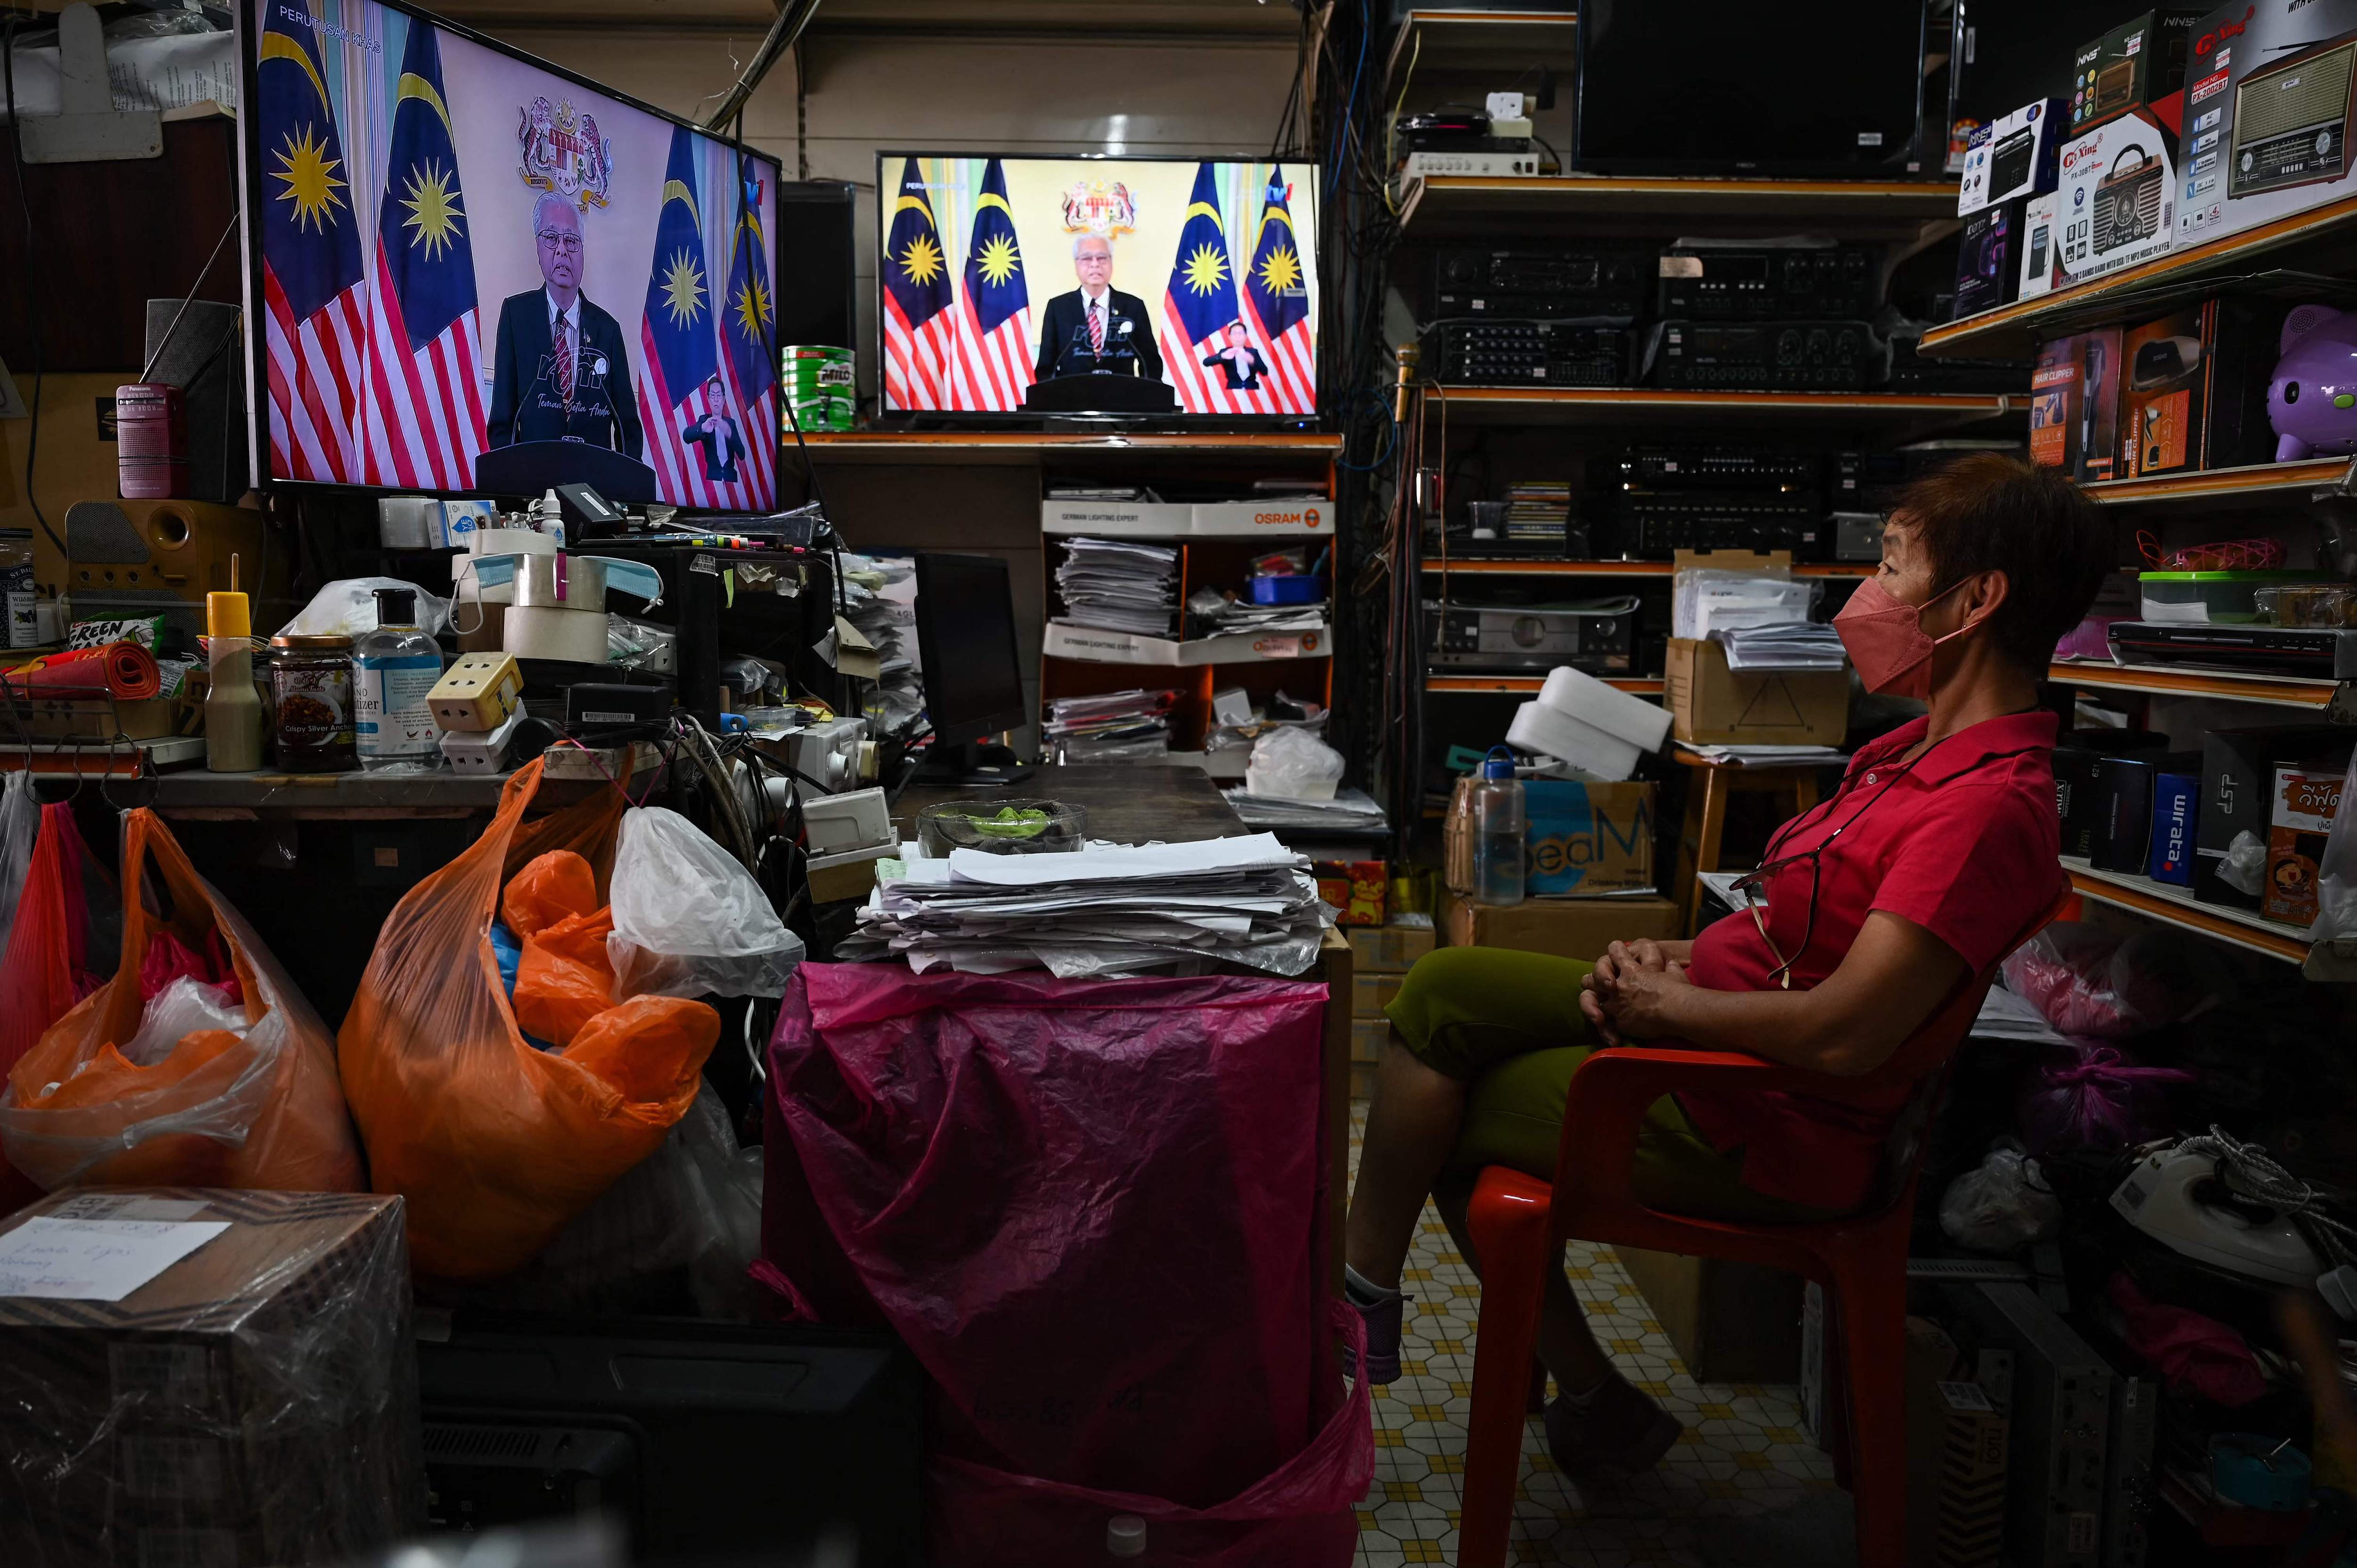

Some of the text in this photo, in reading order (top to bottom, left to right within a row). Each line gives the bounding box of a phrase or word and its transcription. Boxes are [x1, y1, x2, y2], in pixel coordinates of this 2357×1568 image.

[280, 6, 381, 53] PERUTUSAN KHAS
[2192, 80, 2227, 102] PX-2002BT
[2193, 80, 2209, 92] Model
[2078, 143, 2098, 161] Xing
[2083, 267, 2094, 278] BANDS
[2094, 263, 2106, 274] RADIO
[2106, 260, 2116, 271] WITH
[2140, 247, 2153, 258] MUSIC
[2153, 241, 2169, 255] PLAYER
[822, 369, 850, 381] MILO
[2035, 368, 2074, 384] HAIR CLIPPER
[537, 394, 610, 417] Teman Setia Anda
[1255, 513, 1300, 524] OSRAM
[1064, 638, 1139, 652] GERMAN LIGHTING EXPERT
[285, 725, 306, 733] Crispy
